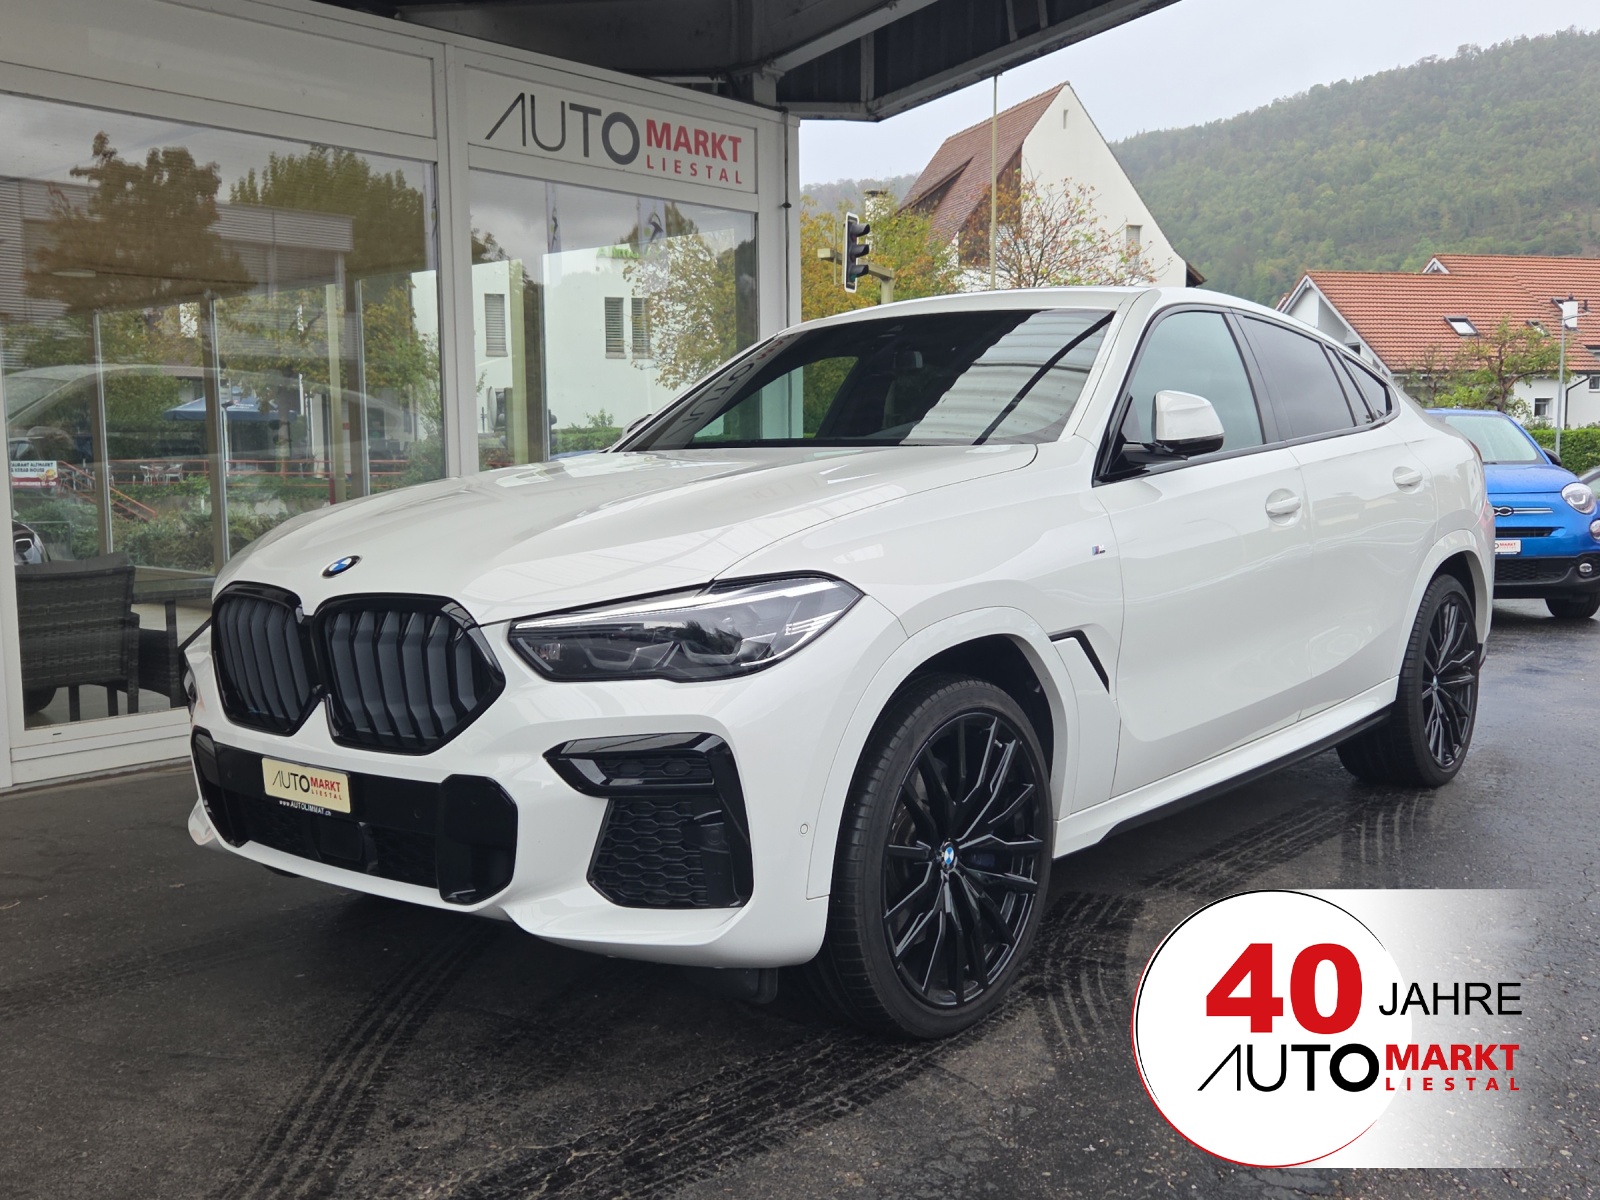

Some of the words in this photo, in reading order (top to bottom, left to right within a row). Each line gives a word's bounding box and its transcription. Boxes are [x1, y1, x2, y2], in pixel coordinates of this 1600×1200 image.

[485, 92, 640, 165] AUTO
[646, 119, 742, 163] MARKT
[647, 154, 742, 185] LIESTAL
[272, 770, 310, 793] AUTO
[310, 777, 341, 792] MARKT
[311, 788, 342, 800] LIESTAL
